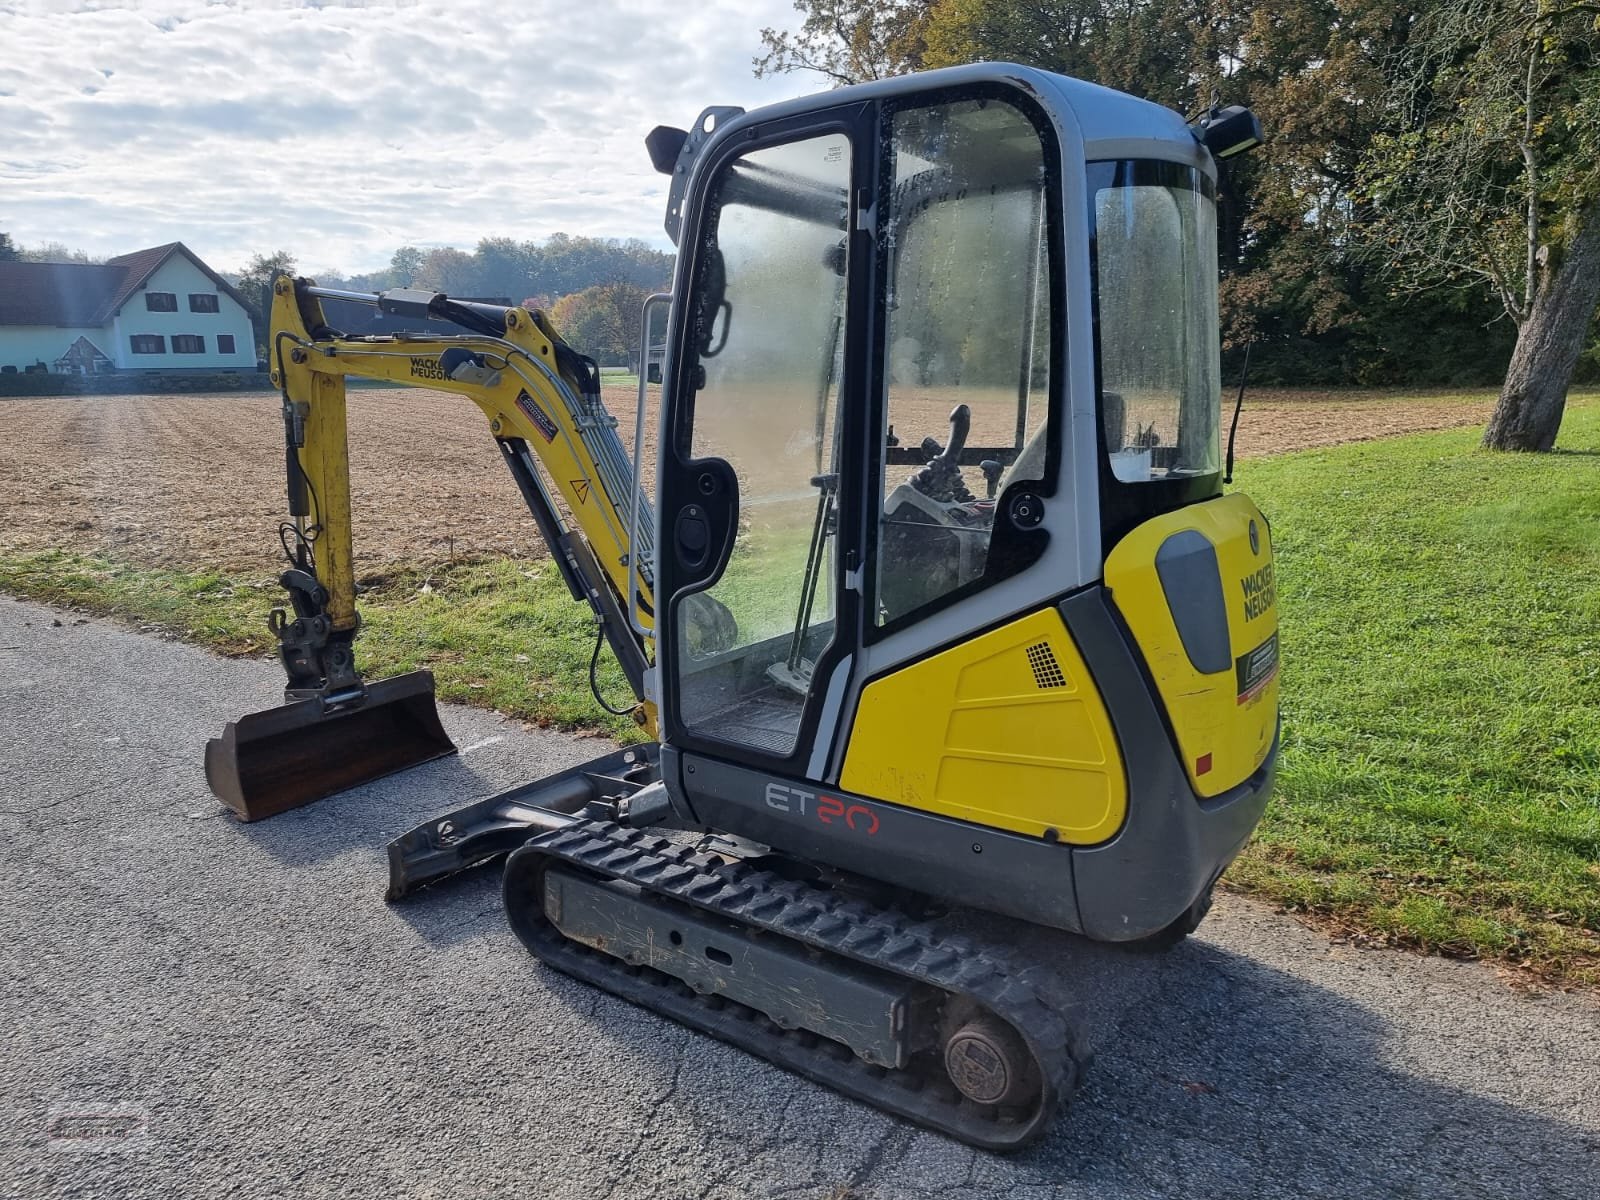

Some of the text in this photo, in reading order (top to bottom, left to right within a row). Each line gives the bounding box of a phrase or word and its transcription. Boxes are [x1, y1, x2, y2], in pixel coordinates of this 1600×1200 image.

[410, 357, 445, 370] WACKE
[1240, 563, 1272, 599] WACKER
[1244, 586, 1275, 623] NEUSON
